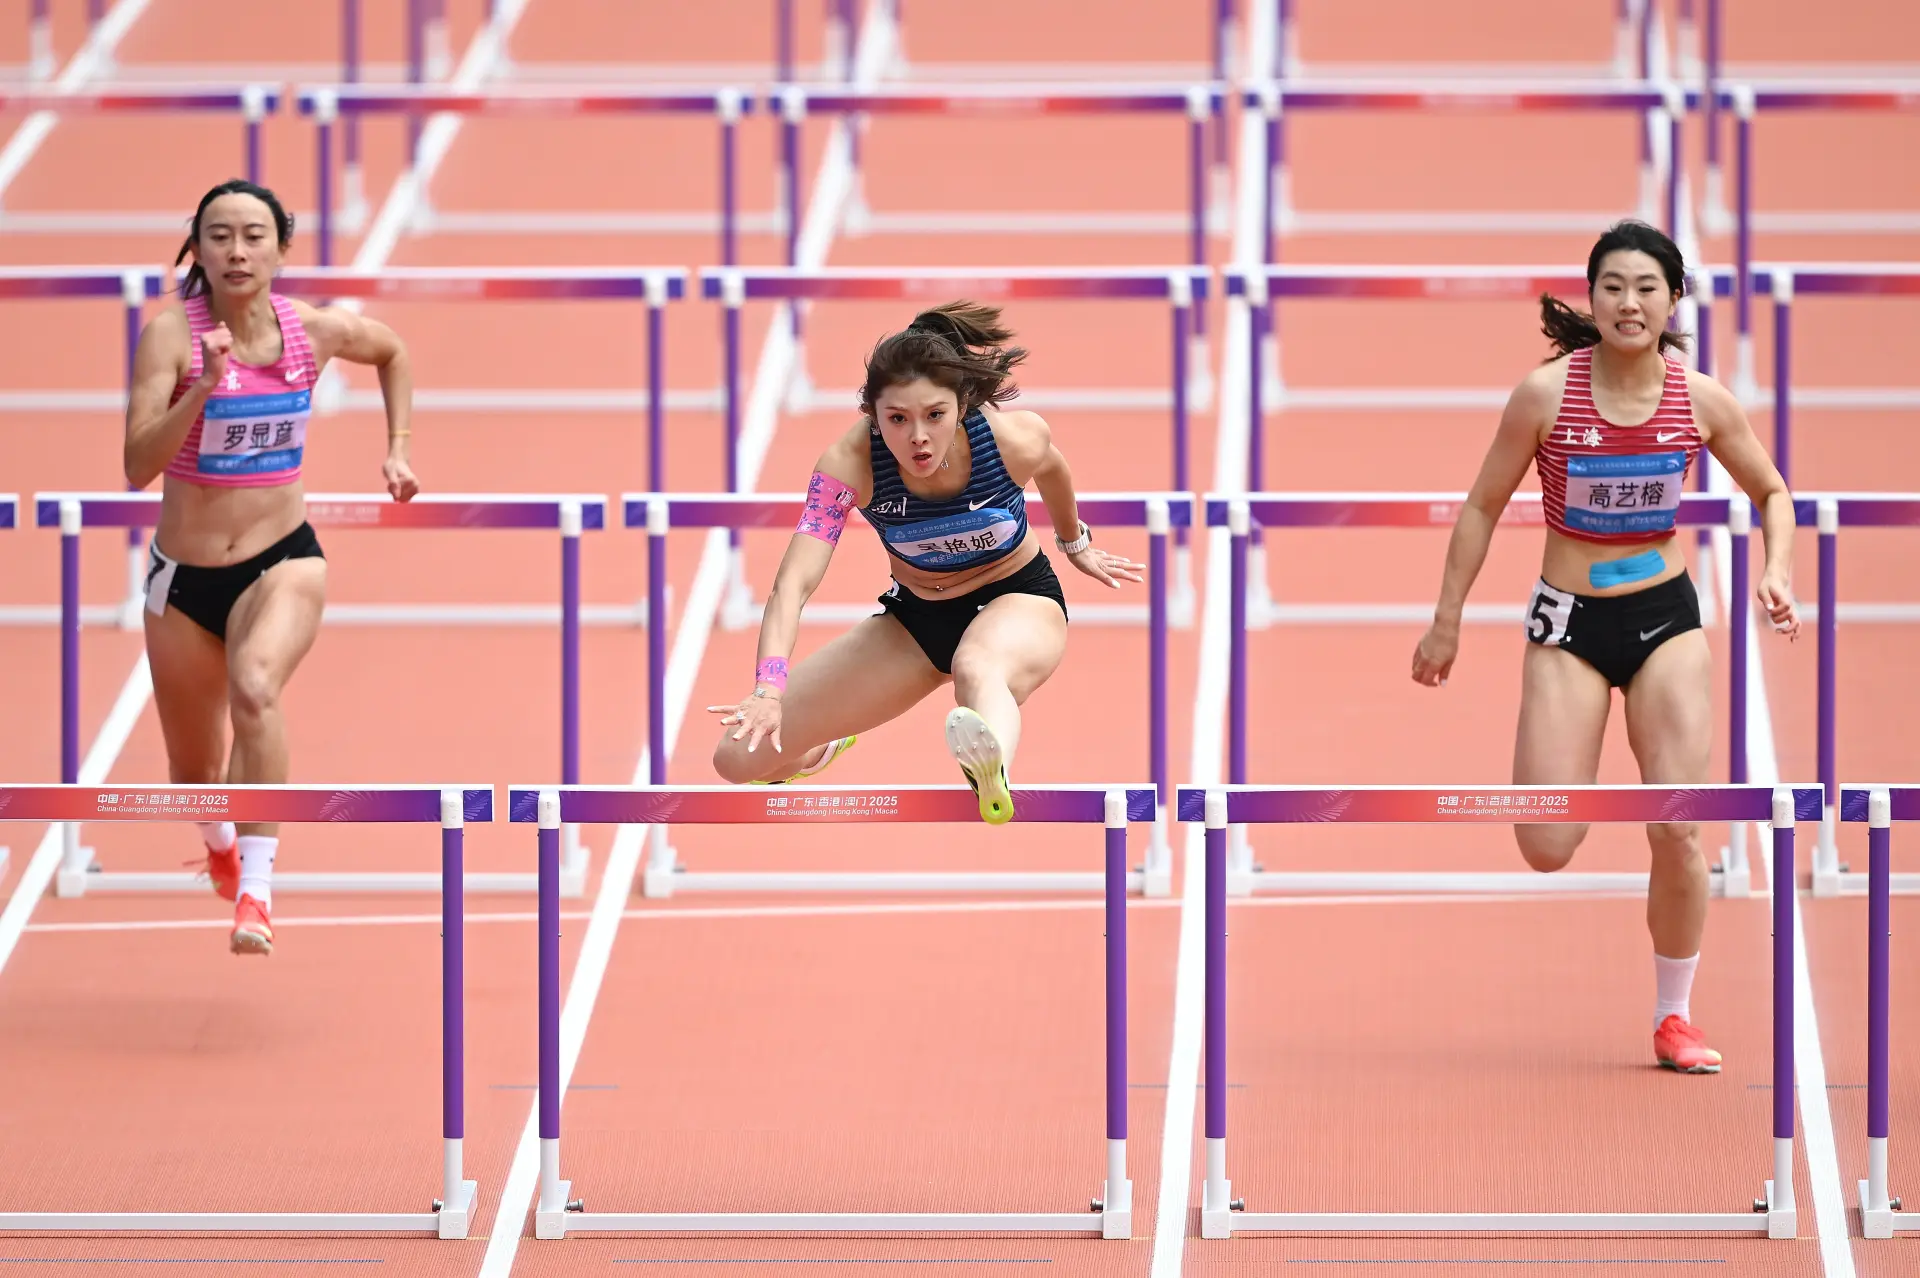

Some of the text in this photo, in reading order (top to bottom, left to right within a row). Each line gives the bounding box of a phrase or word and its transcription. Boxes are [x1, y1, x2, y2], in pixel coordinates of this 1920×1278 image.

[223, 420, 295, 451] 罗显彦
[1560, 427, 1603, 447] 上海
[1588, 480, 1665, 509] 高艺榕
[871, 496, 908, 517] 四川
[1528, 592, 1560, 645] 5
[200, 795, 229, 805] 2025
[869, 796, 898, 807] 2025
[1540, 795, 1569, 806] 2025
[162, 806, 181, 814] Hong
[183, 806, 200, 814] Kong
[205, 806, 229, 814] Macao
[832, 808, 851, 816] Hong
[852, 808, 870, 816] Kong
[1502, 807, 1521, 815] Hong
[1523, 807, 1540, 815] Kong
[1545, 807, 1569, 815] Macao
